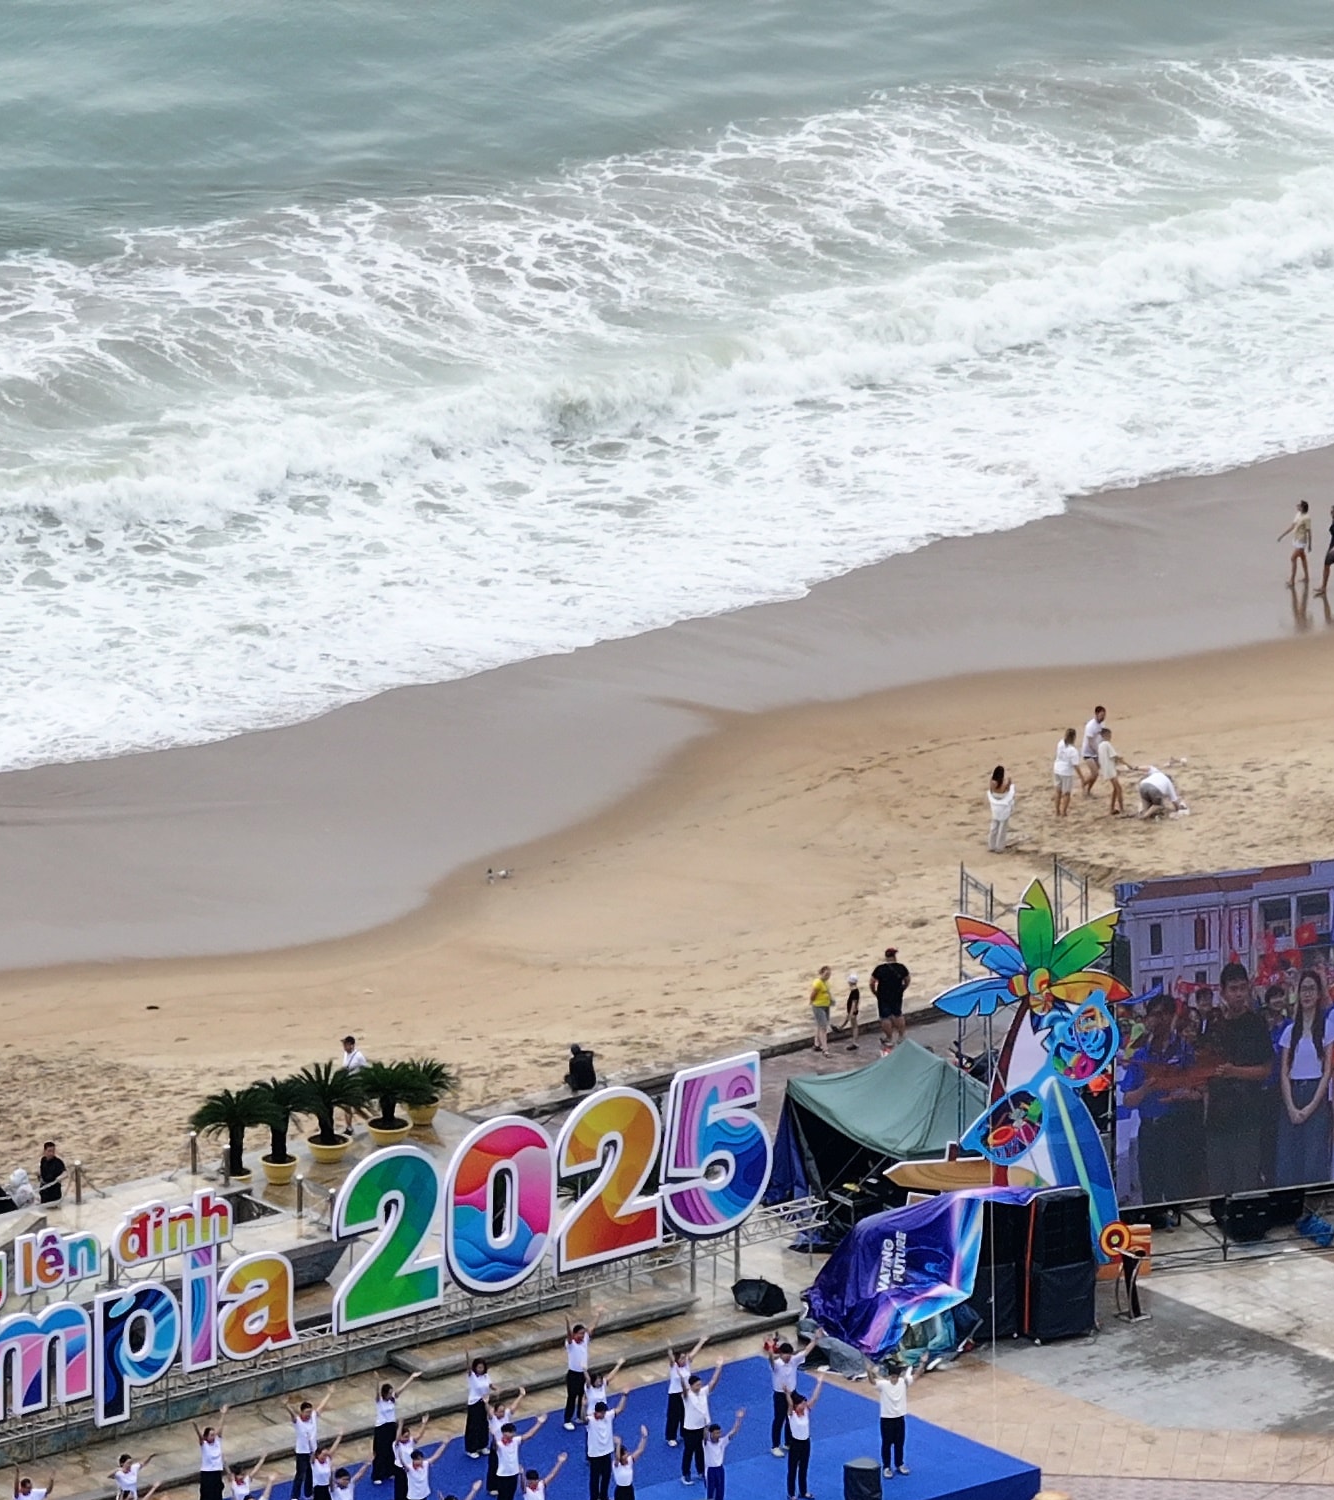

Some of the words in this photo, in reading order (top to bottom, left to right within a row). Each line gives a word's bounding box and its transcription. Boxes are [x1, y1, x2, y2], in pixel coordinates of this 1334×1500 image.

[14, 1227, 101, 1296] lên
[111, 1188, 234, 1268] đỉnh
[333, 1051, 774, 1335] 2025
[892, 1230, 907, 1283] FUTURE
